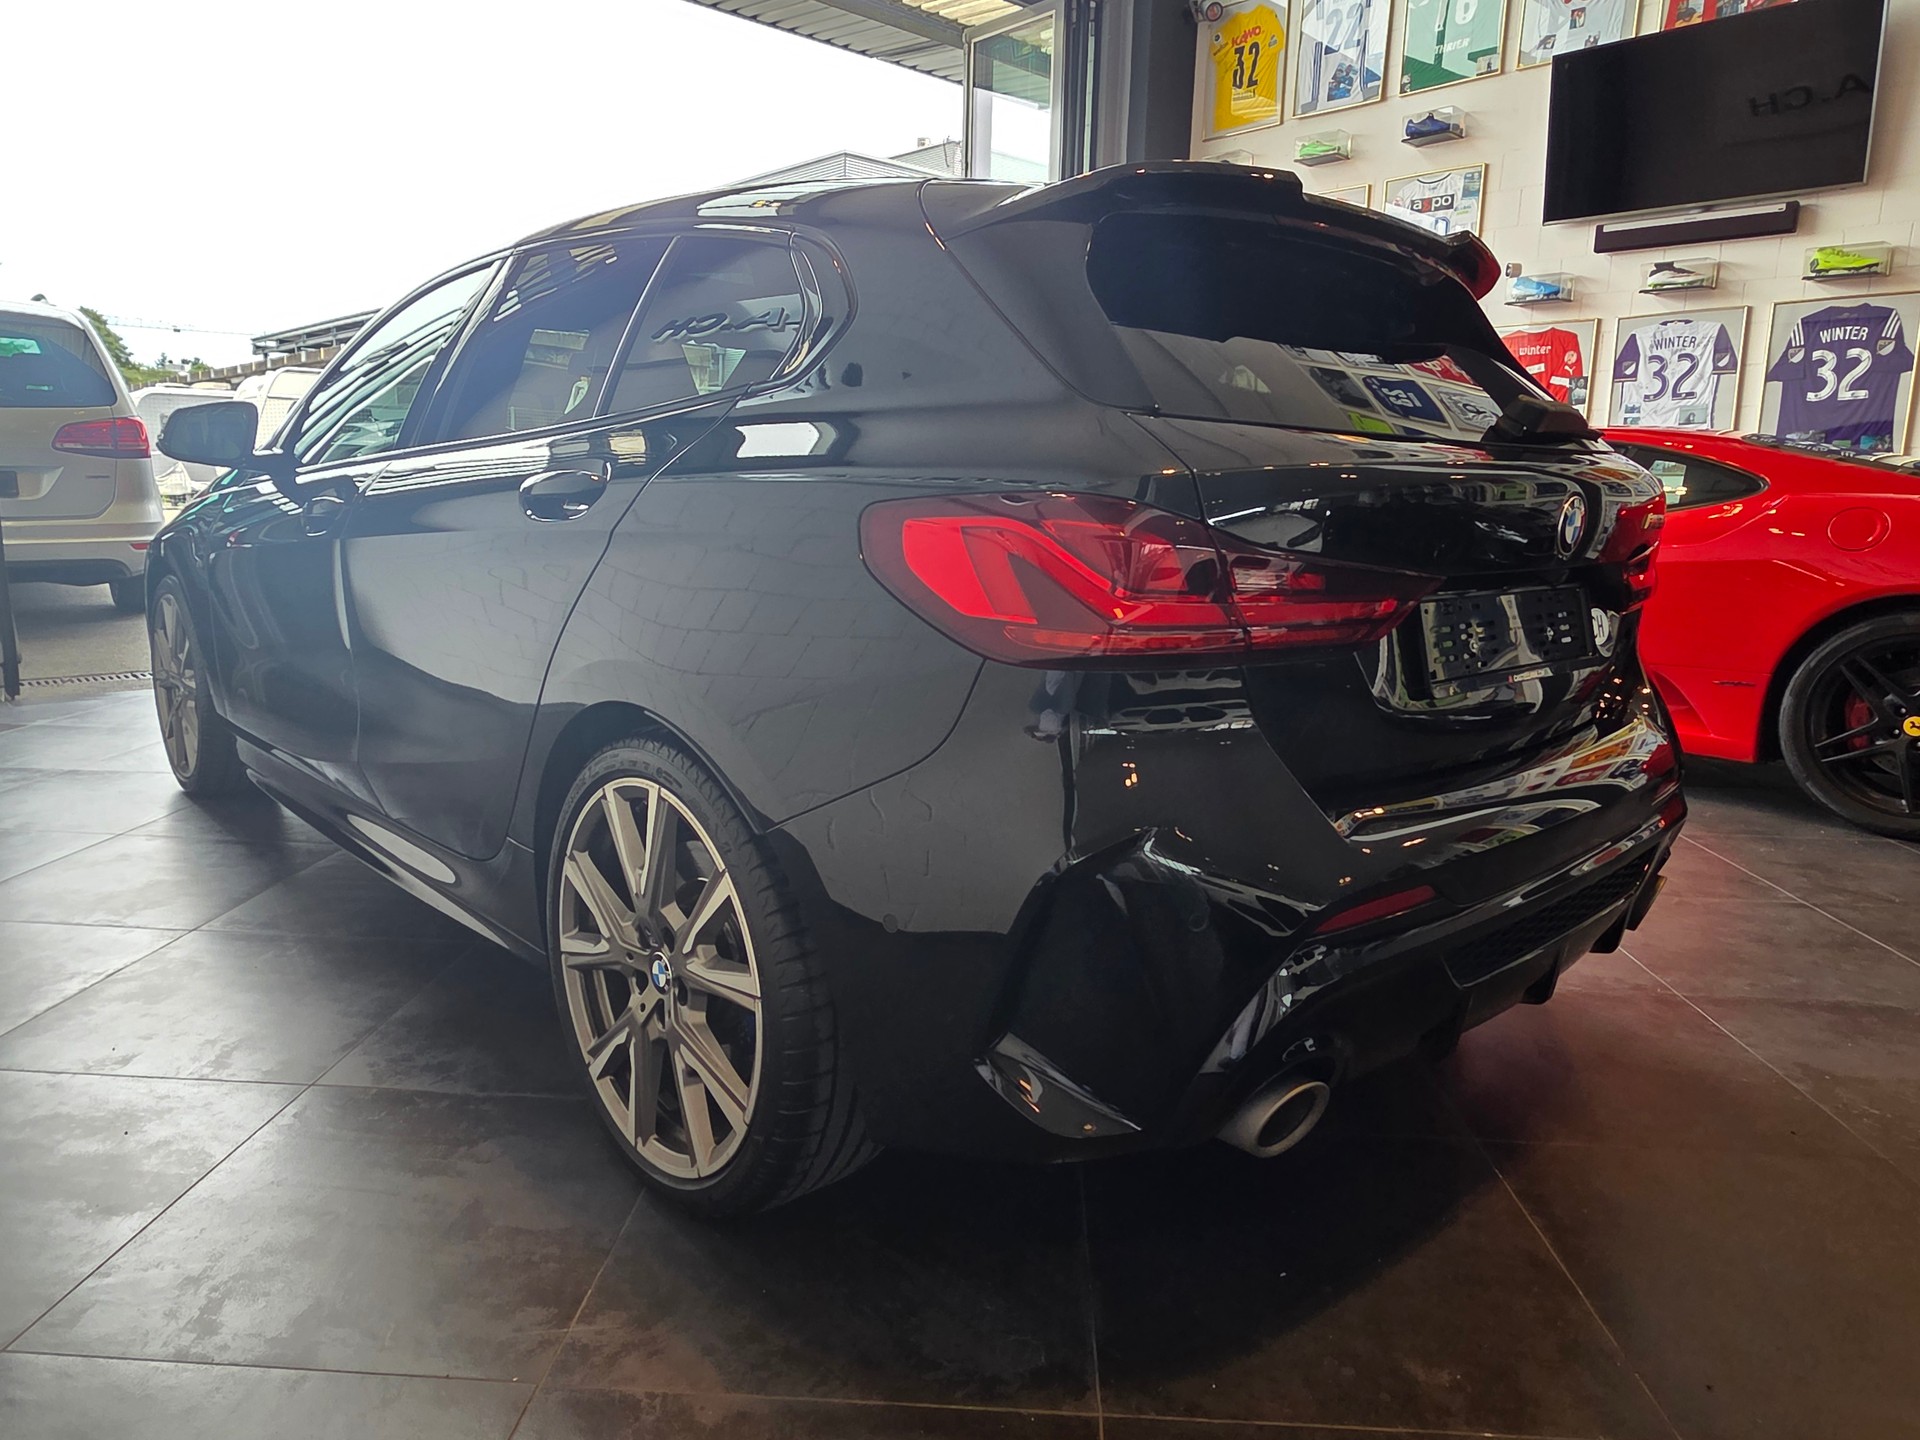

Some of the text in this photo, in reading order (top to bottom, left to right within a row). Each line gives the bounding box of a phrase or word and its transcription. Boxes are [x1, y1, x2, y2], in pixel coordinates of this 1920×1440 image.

[1232, 41, 1260, 89] 32
[1413, 195, 1452, 211] aspo
[1654, 335, 1697, 350] WINTER
[1820, 326, 1868, 343] WINTER
[1519, 345, 1551, 355] winter
[1643, 353, 1699, 402] 32
[1806, 348, 1872, 401] 32
